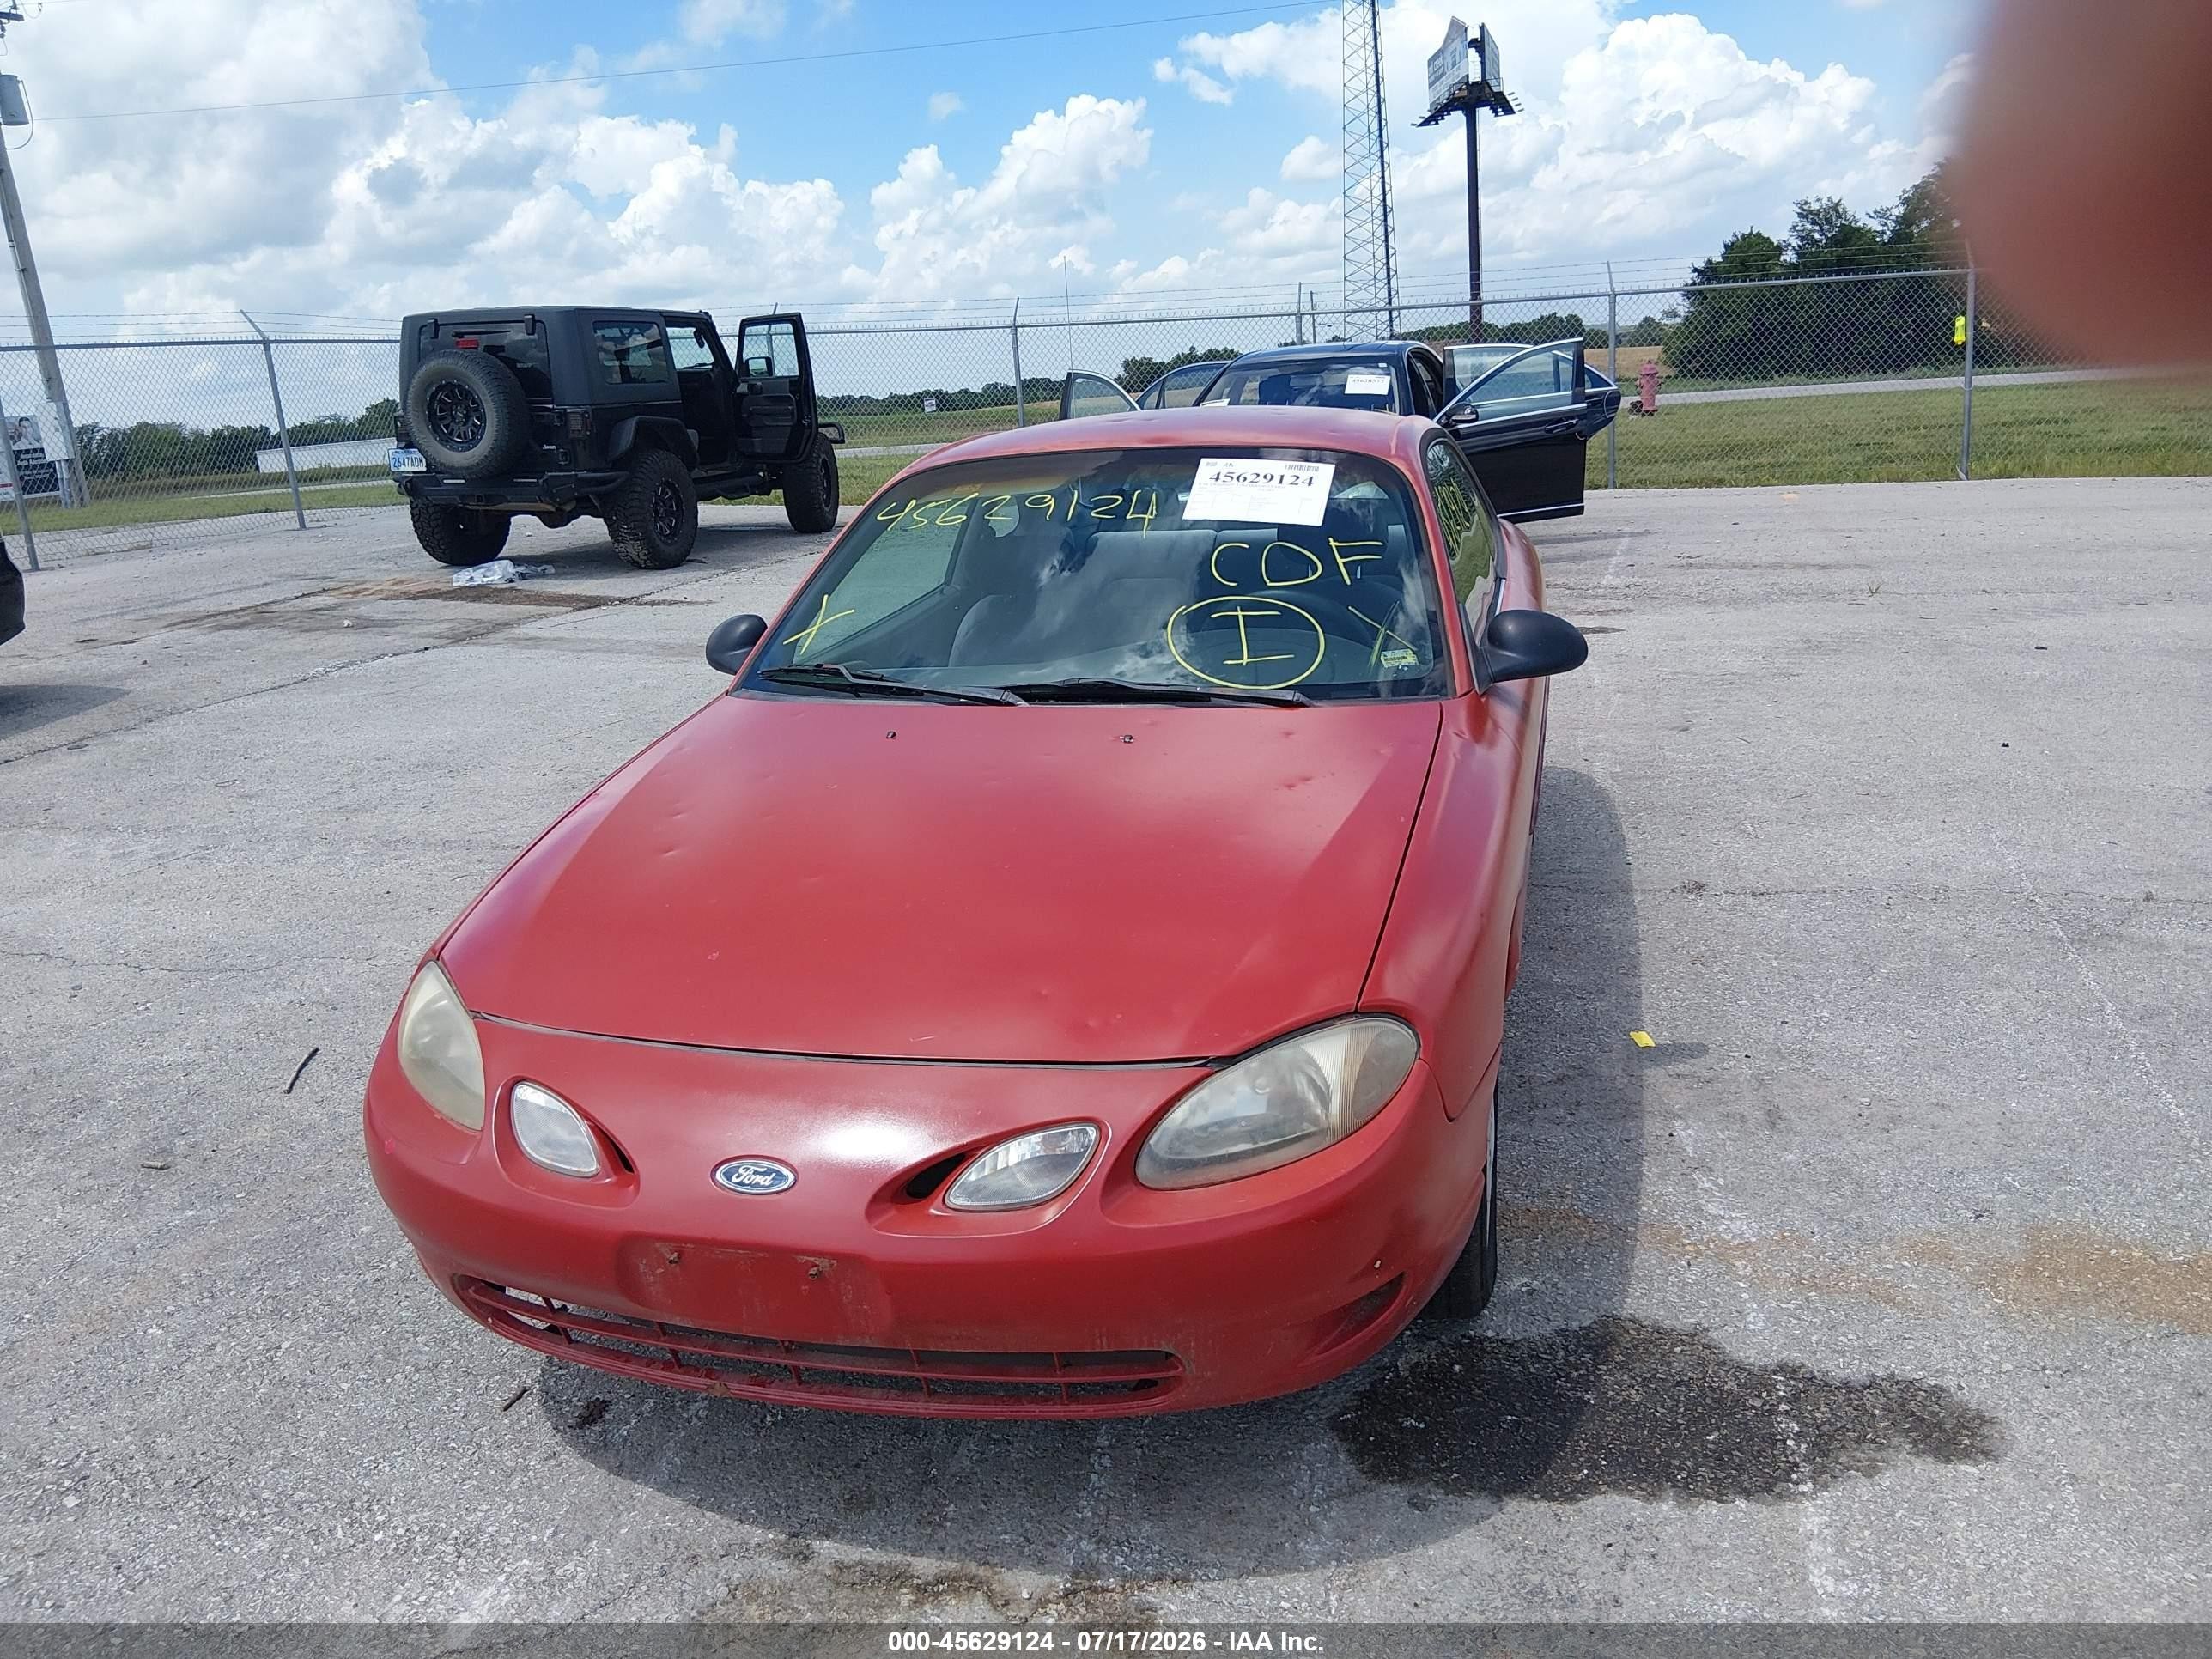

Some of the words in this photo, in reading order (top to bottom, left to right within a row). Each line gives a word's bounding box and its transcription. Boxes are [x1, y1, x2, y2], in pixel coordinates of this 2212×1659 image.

[1209, 471, 1314, 487] 45629124
[877, 489, 1158, 539] 45629124
[732, 1164, 776, 1186] Ford
